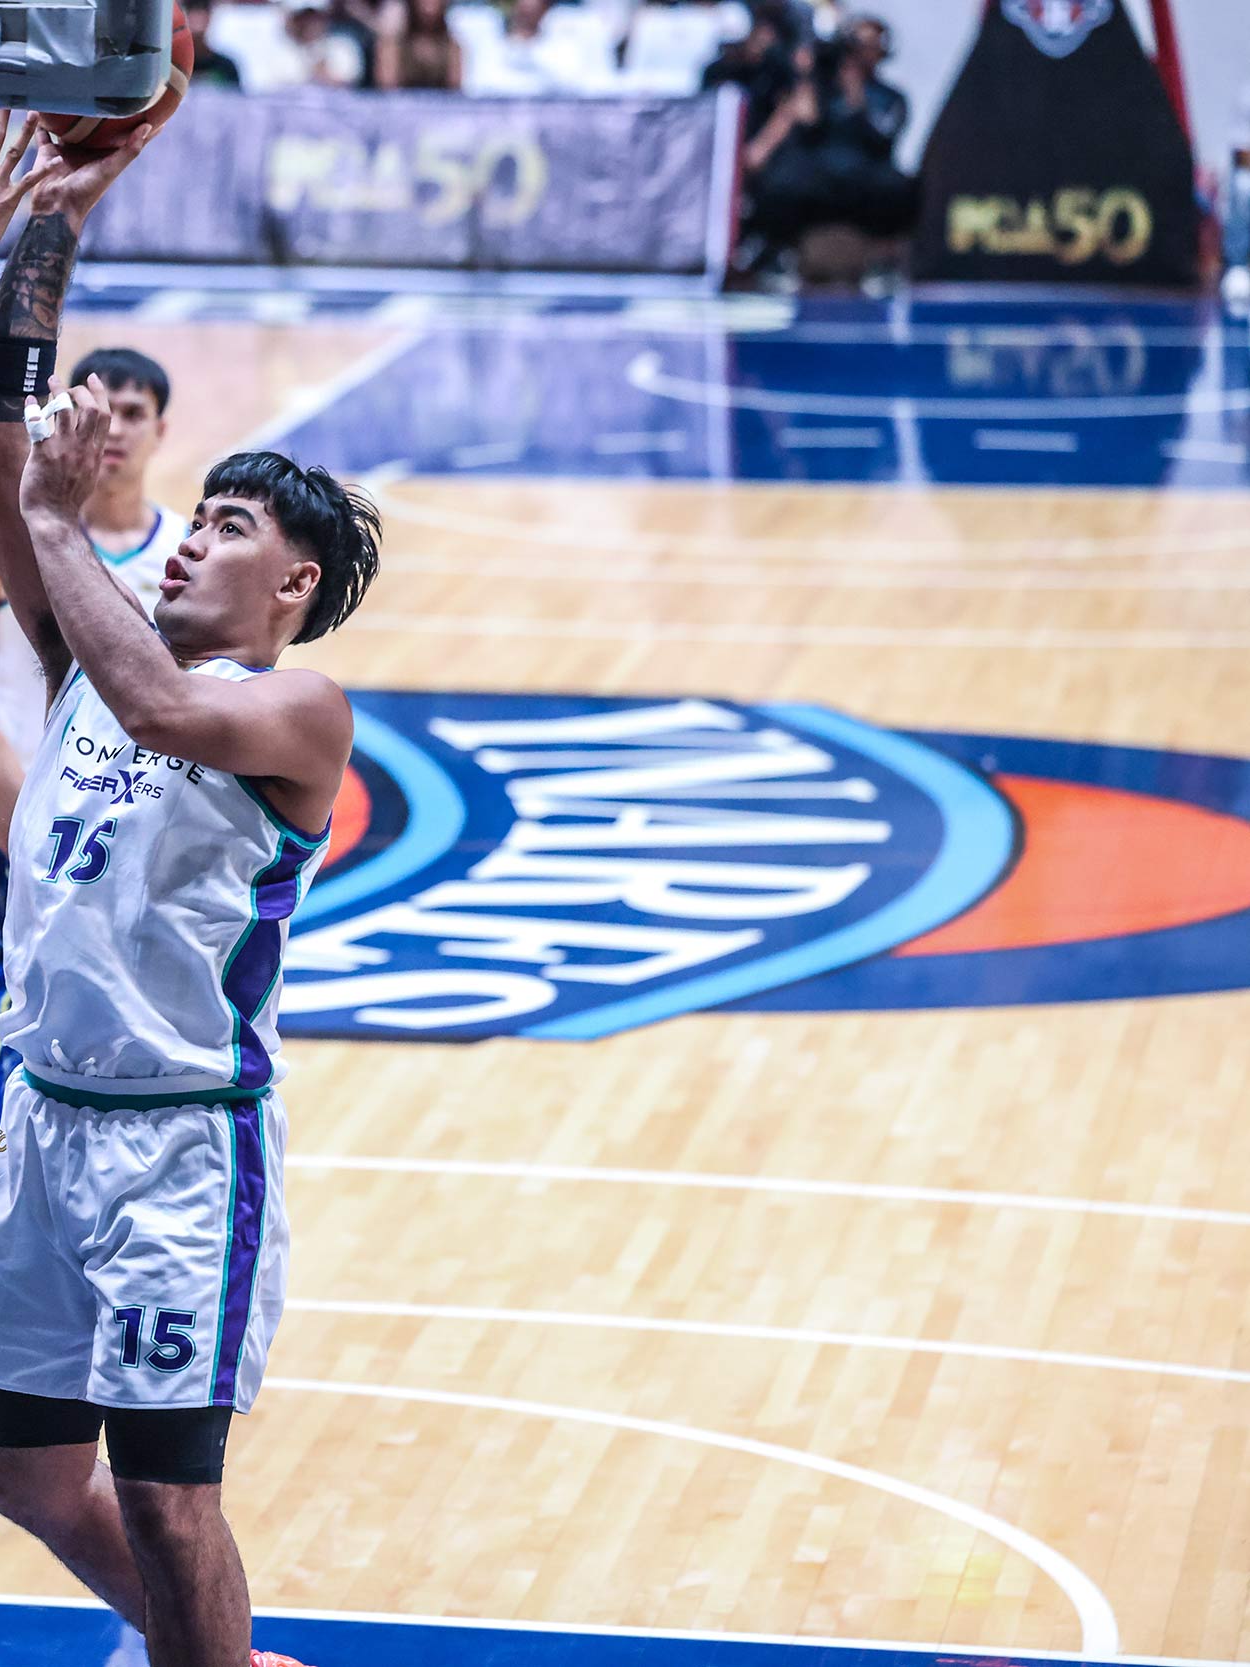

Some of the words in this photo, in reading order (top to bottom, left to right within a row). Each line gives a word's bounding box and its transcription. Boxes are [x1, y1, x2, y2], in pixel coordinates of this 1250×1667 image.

[66, 726, 205, 785] ONERGE
[41, 816, 118, 885] 15
[113, 1304, 196, 1373] 15
